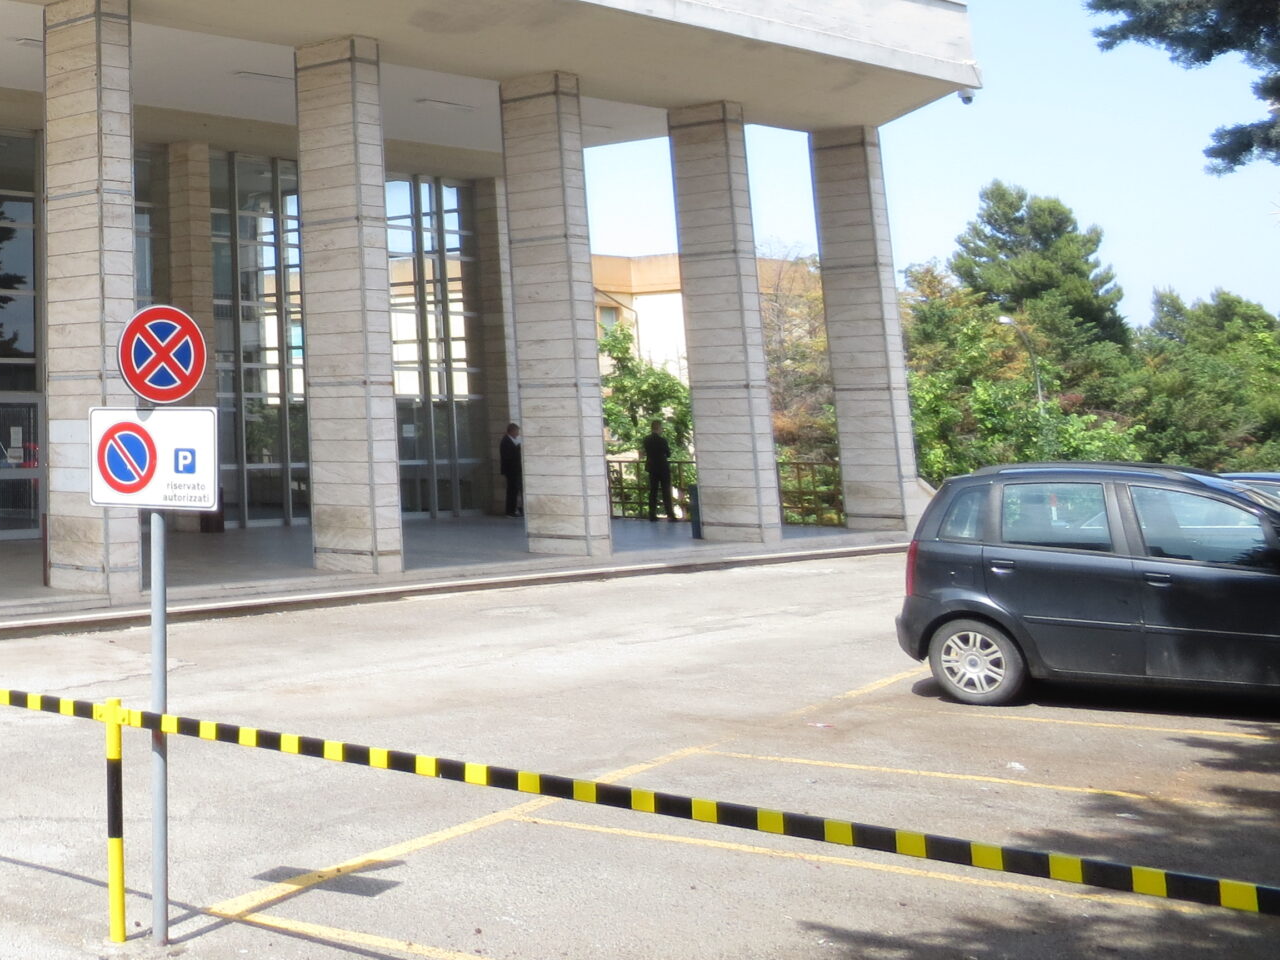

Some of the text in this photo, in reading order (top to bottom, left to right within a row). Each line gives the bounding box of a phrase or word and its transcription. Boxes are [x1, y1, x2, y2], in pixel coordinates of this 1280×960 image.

[178, 451, 192, 471] P
[166, 481, 206, 490] riservato
[162, 493, 210, 502] autorizzati
